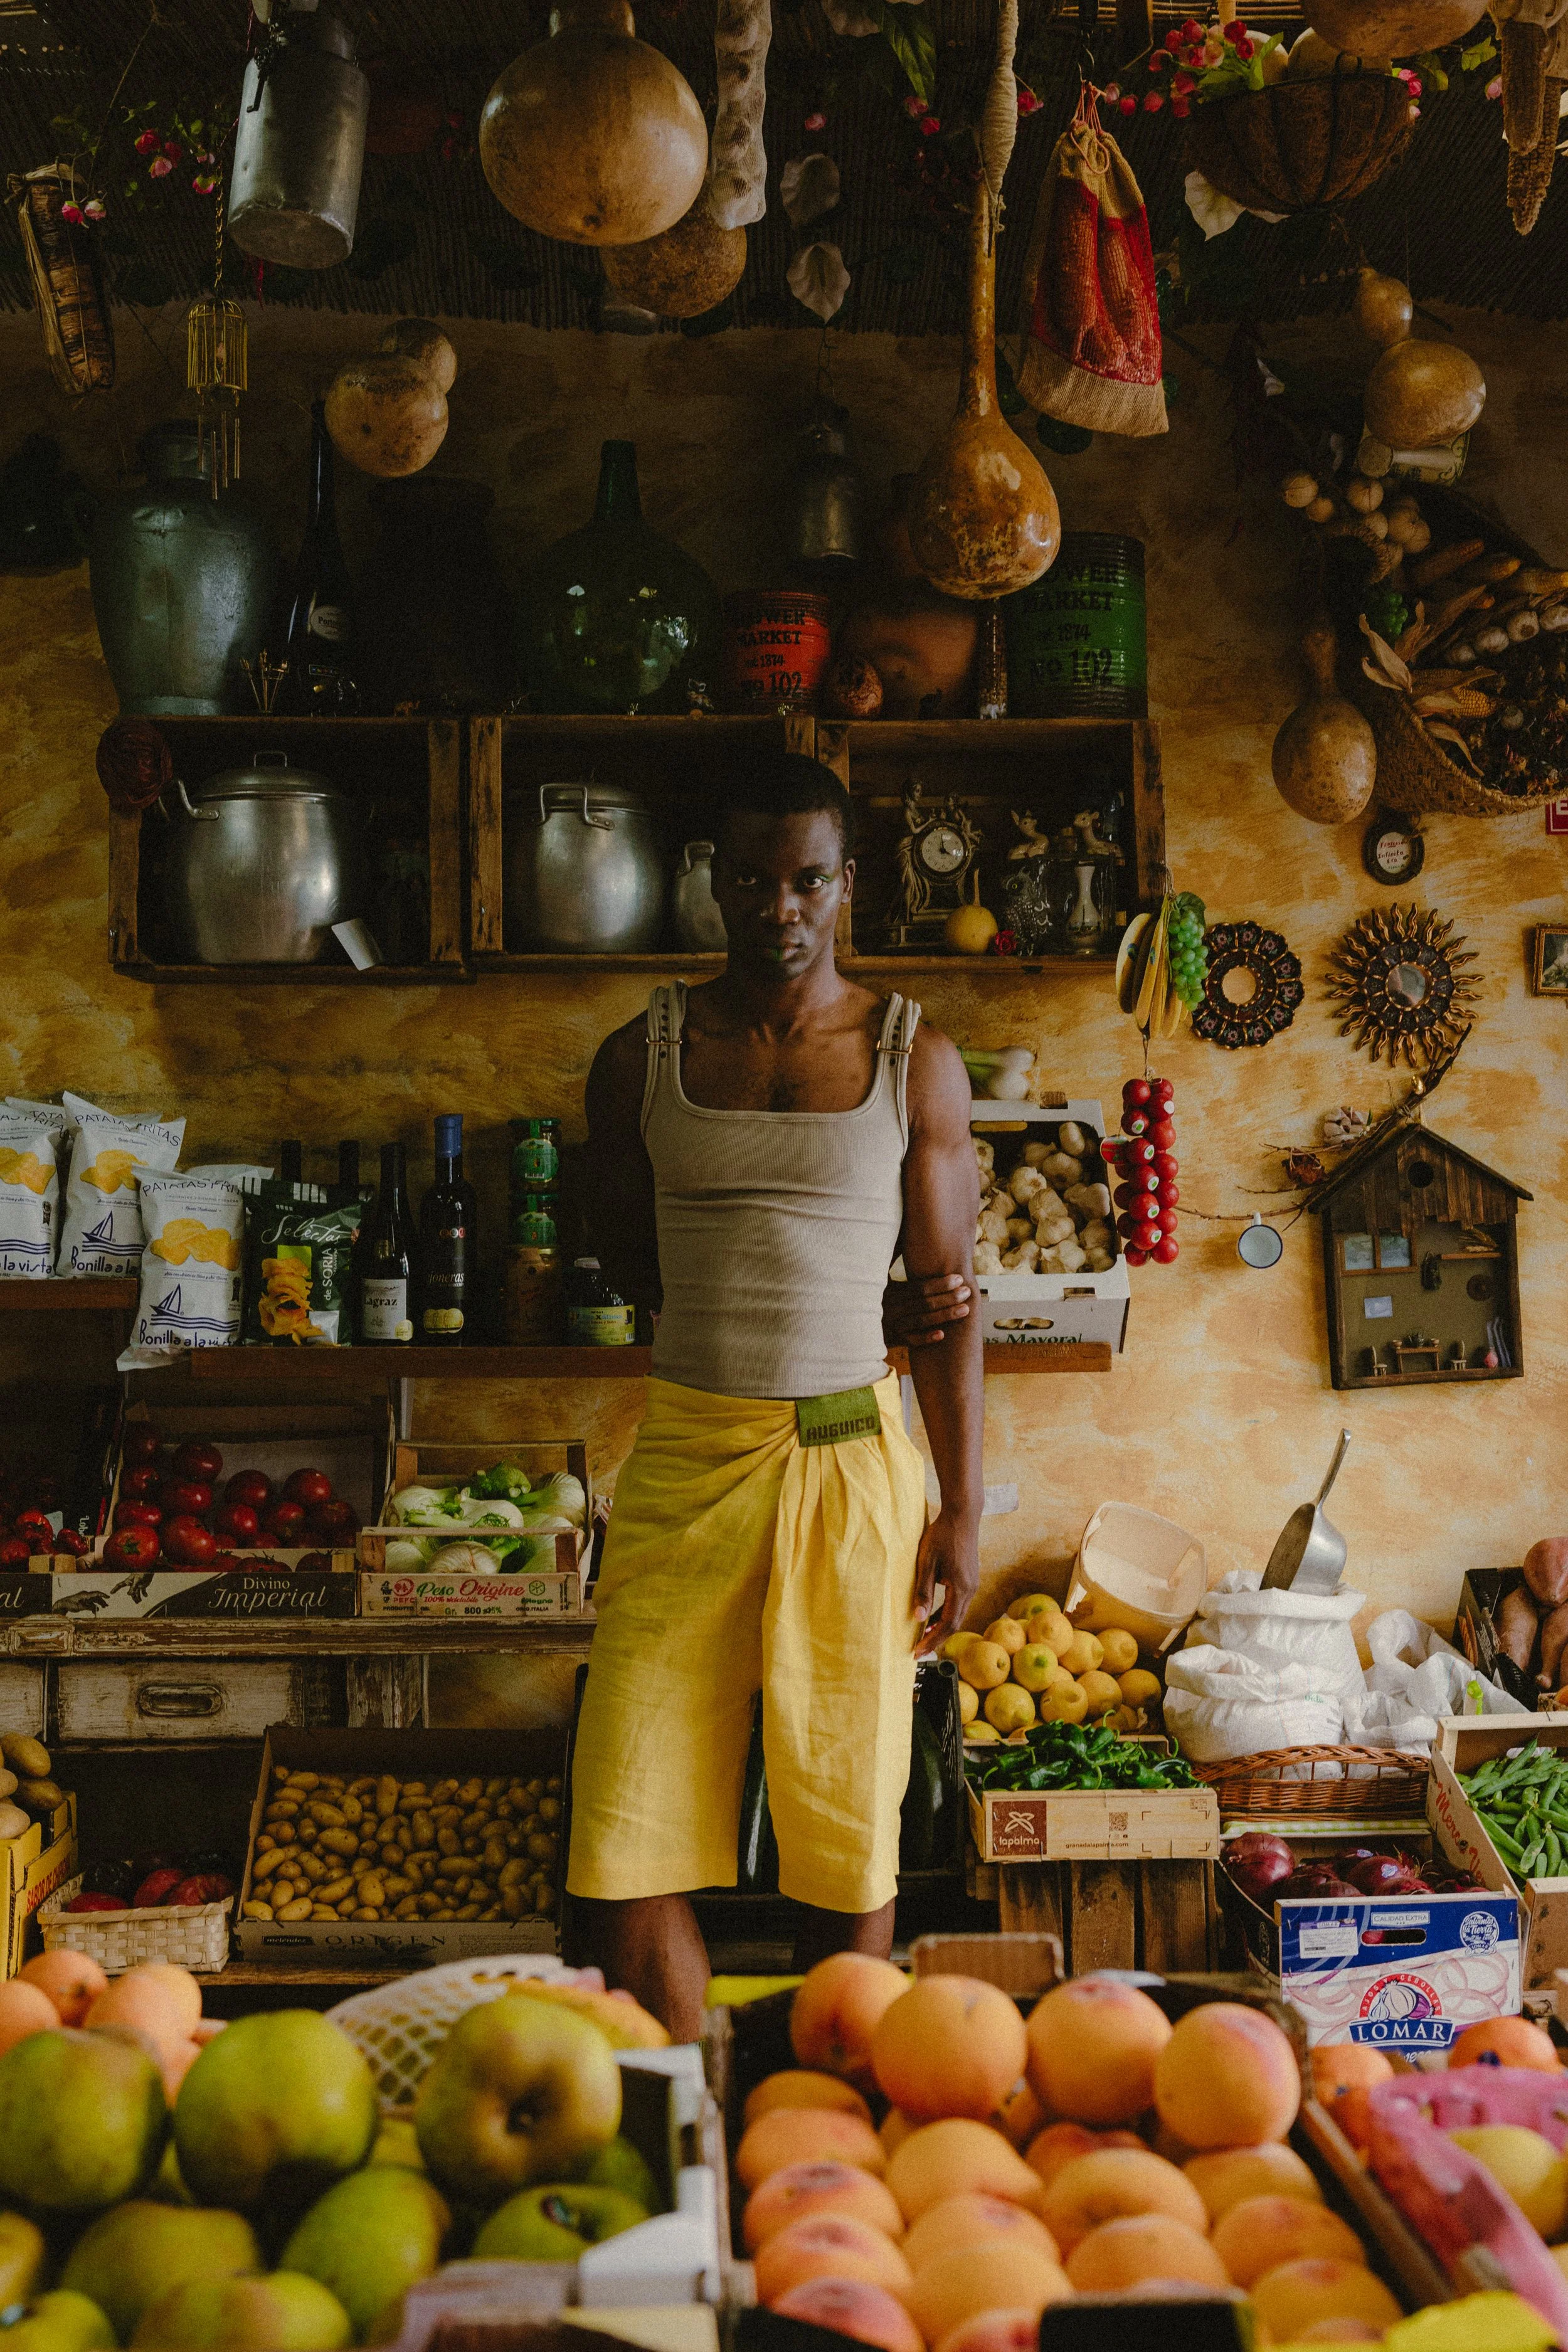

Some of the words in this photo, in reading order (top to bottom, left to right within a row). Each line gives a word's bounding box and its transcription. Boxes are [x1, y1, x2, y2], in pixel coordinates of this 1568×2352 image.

[760, 654, 785, 667] 1874
[1071, 647, 1112, 685] 102
[769, 671, 802, 699] 102
[71, 1246, 112, 1273] Bonilla
[321, 1248, 333, 1287] SORIA
[323, 1289, 332, 1301] de
[139, 1318, 181, 1345] Bonilla
[194, 1331, 206, 1348] la
[243, 1577, 291, 1591] Divino
[416, 1581, 455, 1597] Peso
[460, 1579, 526, 1602] Origine
[208, 1586, 329, 1613] Imperial
[999, 1836, 1040, 1848] lapalma
[1399, 1974, 1441, 2011] CEBOLLAS
[1357, 2021, 1446, 2042] LOMAR
